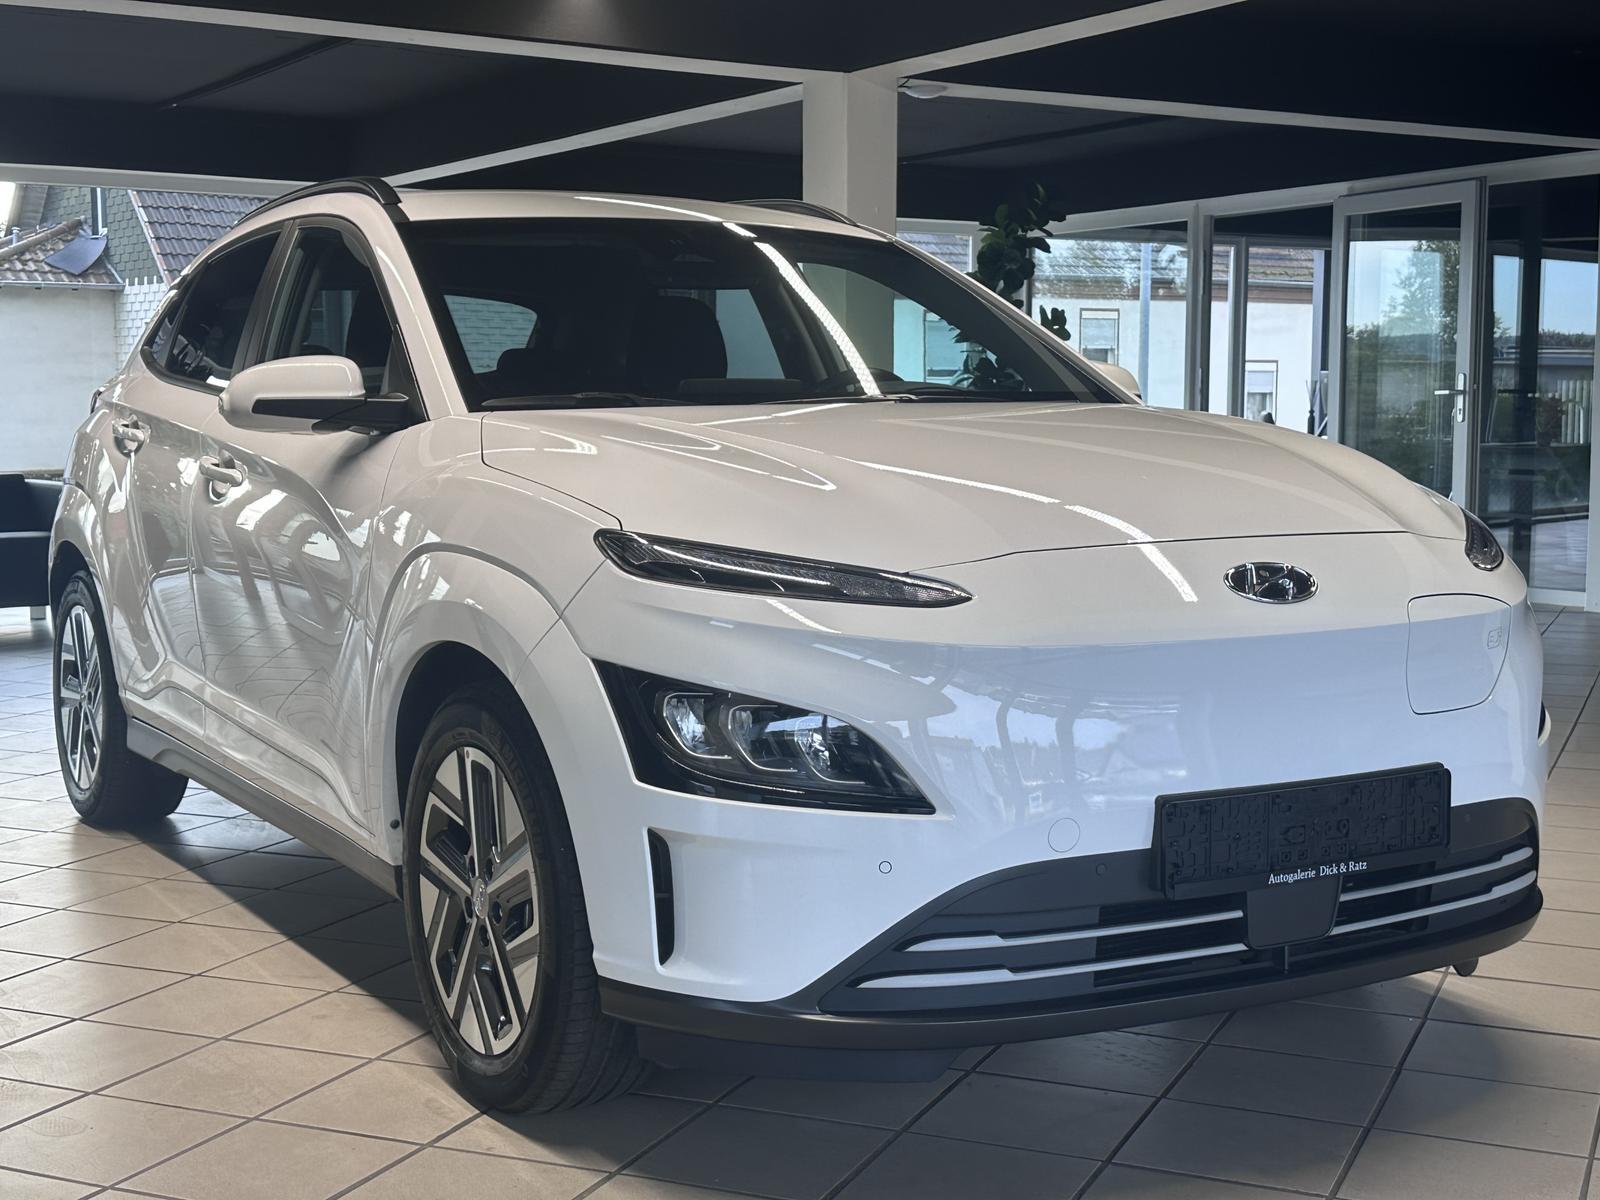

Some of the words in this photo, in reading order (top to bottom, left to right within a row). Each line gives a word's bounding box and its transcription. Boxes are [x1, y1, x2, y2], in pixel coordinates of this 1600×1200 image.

[1268, 868, 1316, 884] Autogalerie
[1320, 864, 1338, 876] Dick
[1340, 862, 1347, 873] &
[1349, 861, 1367, 872] Ratz
